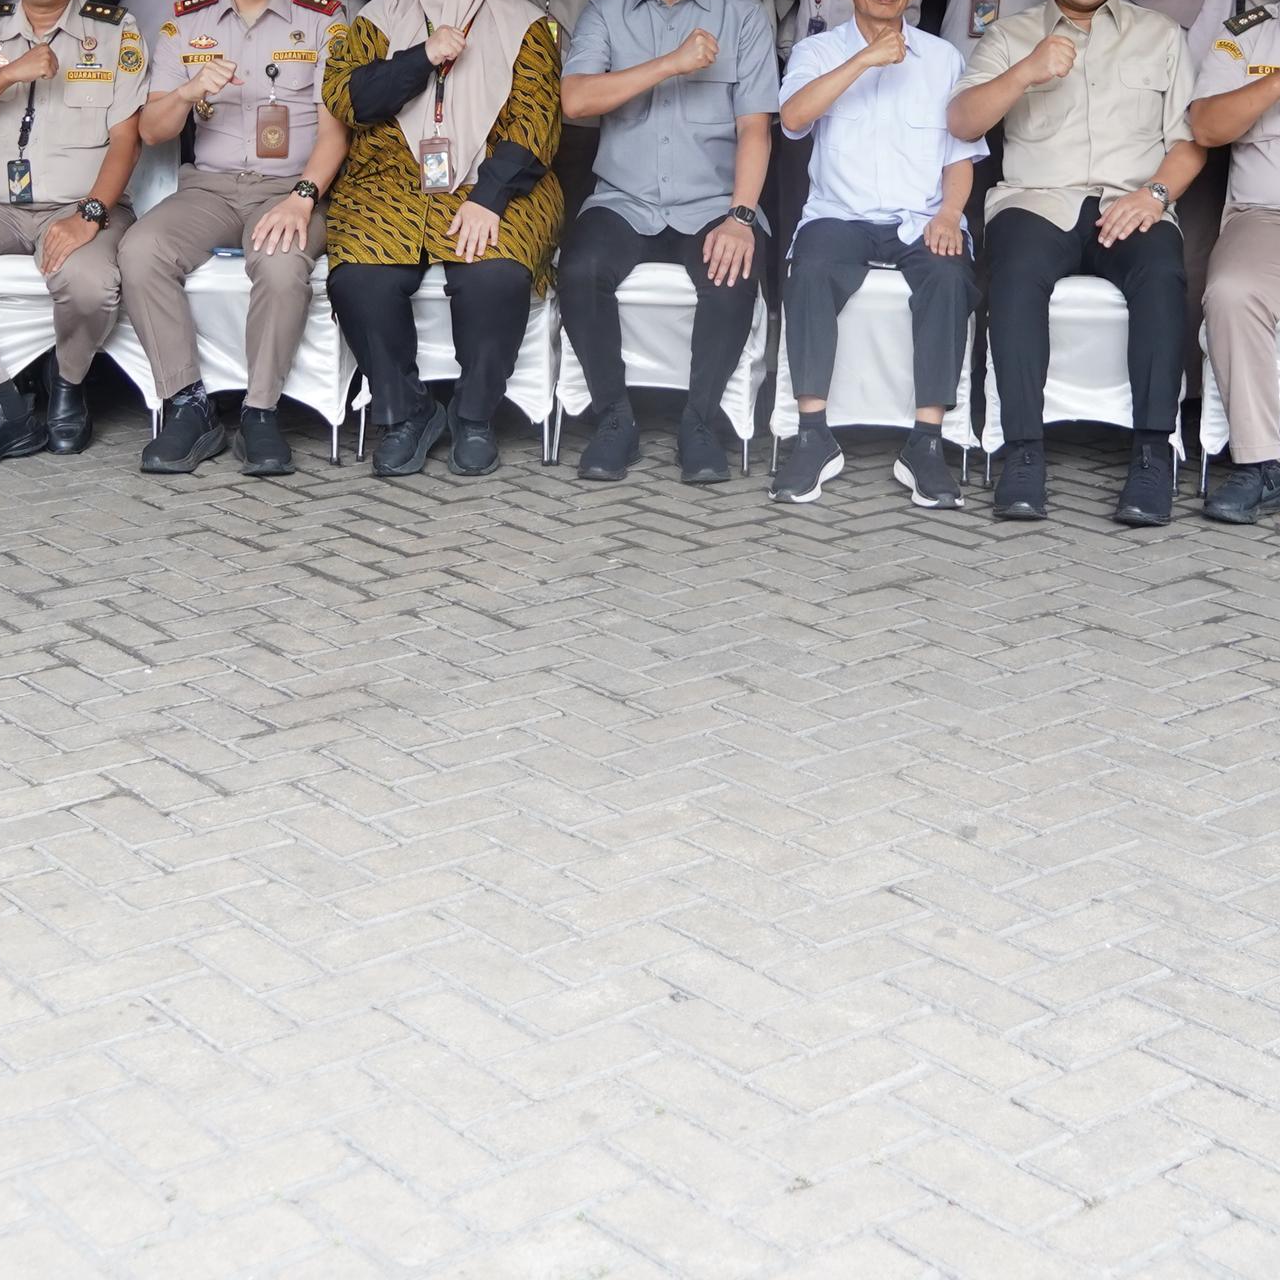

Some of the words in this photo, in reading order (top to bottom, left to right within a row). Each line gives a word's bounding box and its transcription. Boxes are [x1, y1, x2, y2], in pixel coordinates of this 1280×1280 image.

[188, 53, 215, 63] FERDI
[273, 52, 317, 62] QUARANTINE
[67, 71, 113, 81] QUARANTINE
